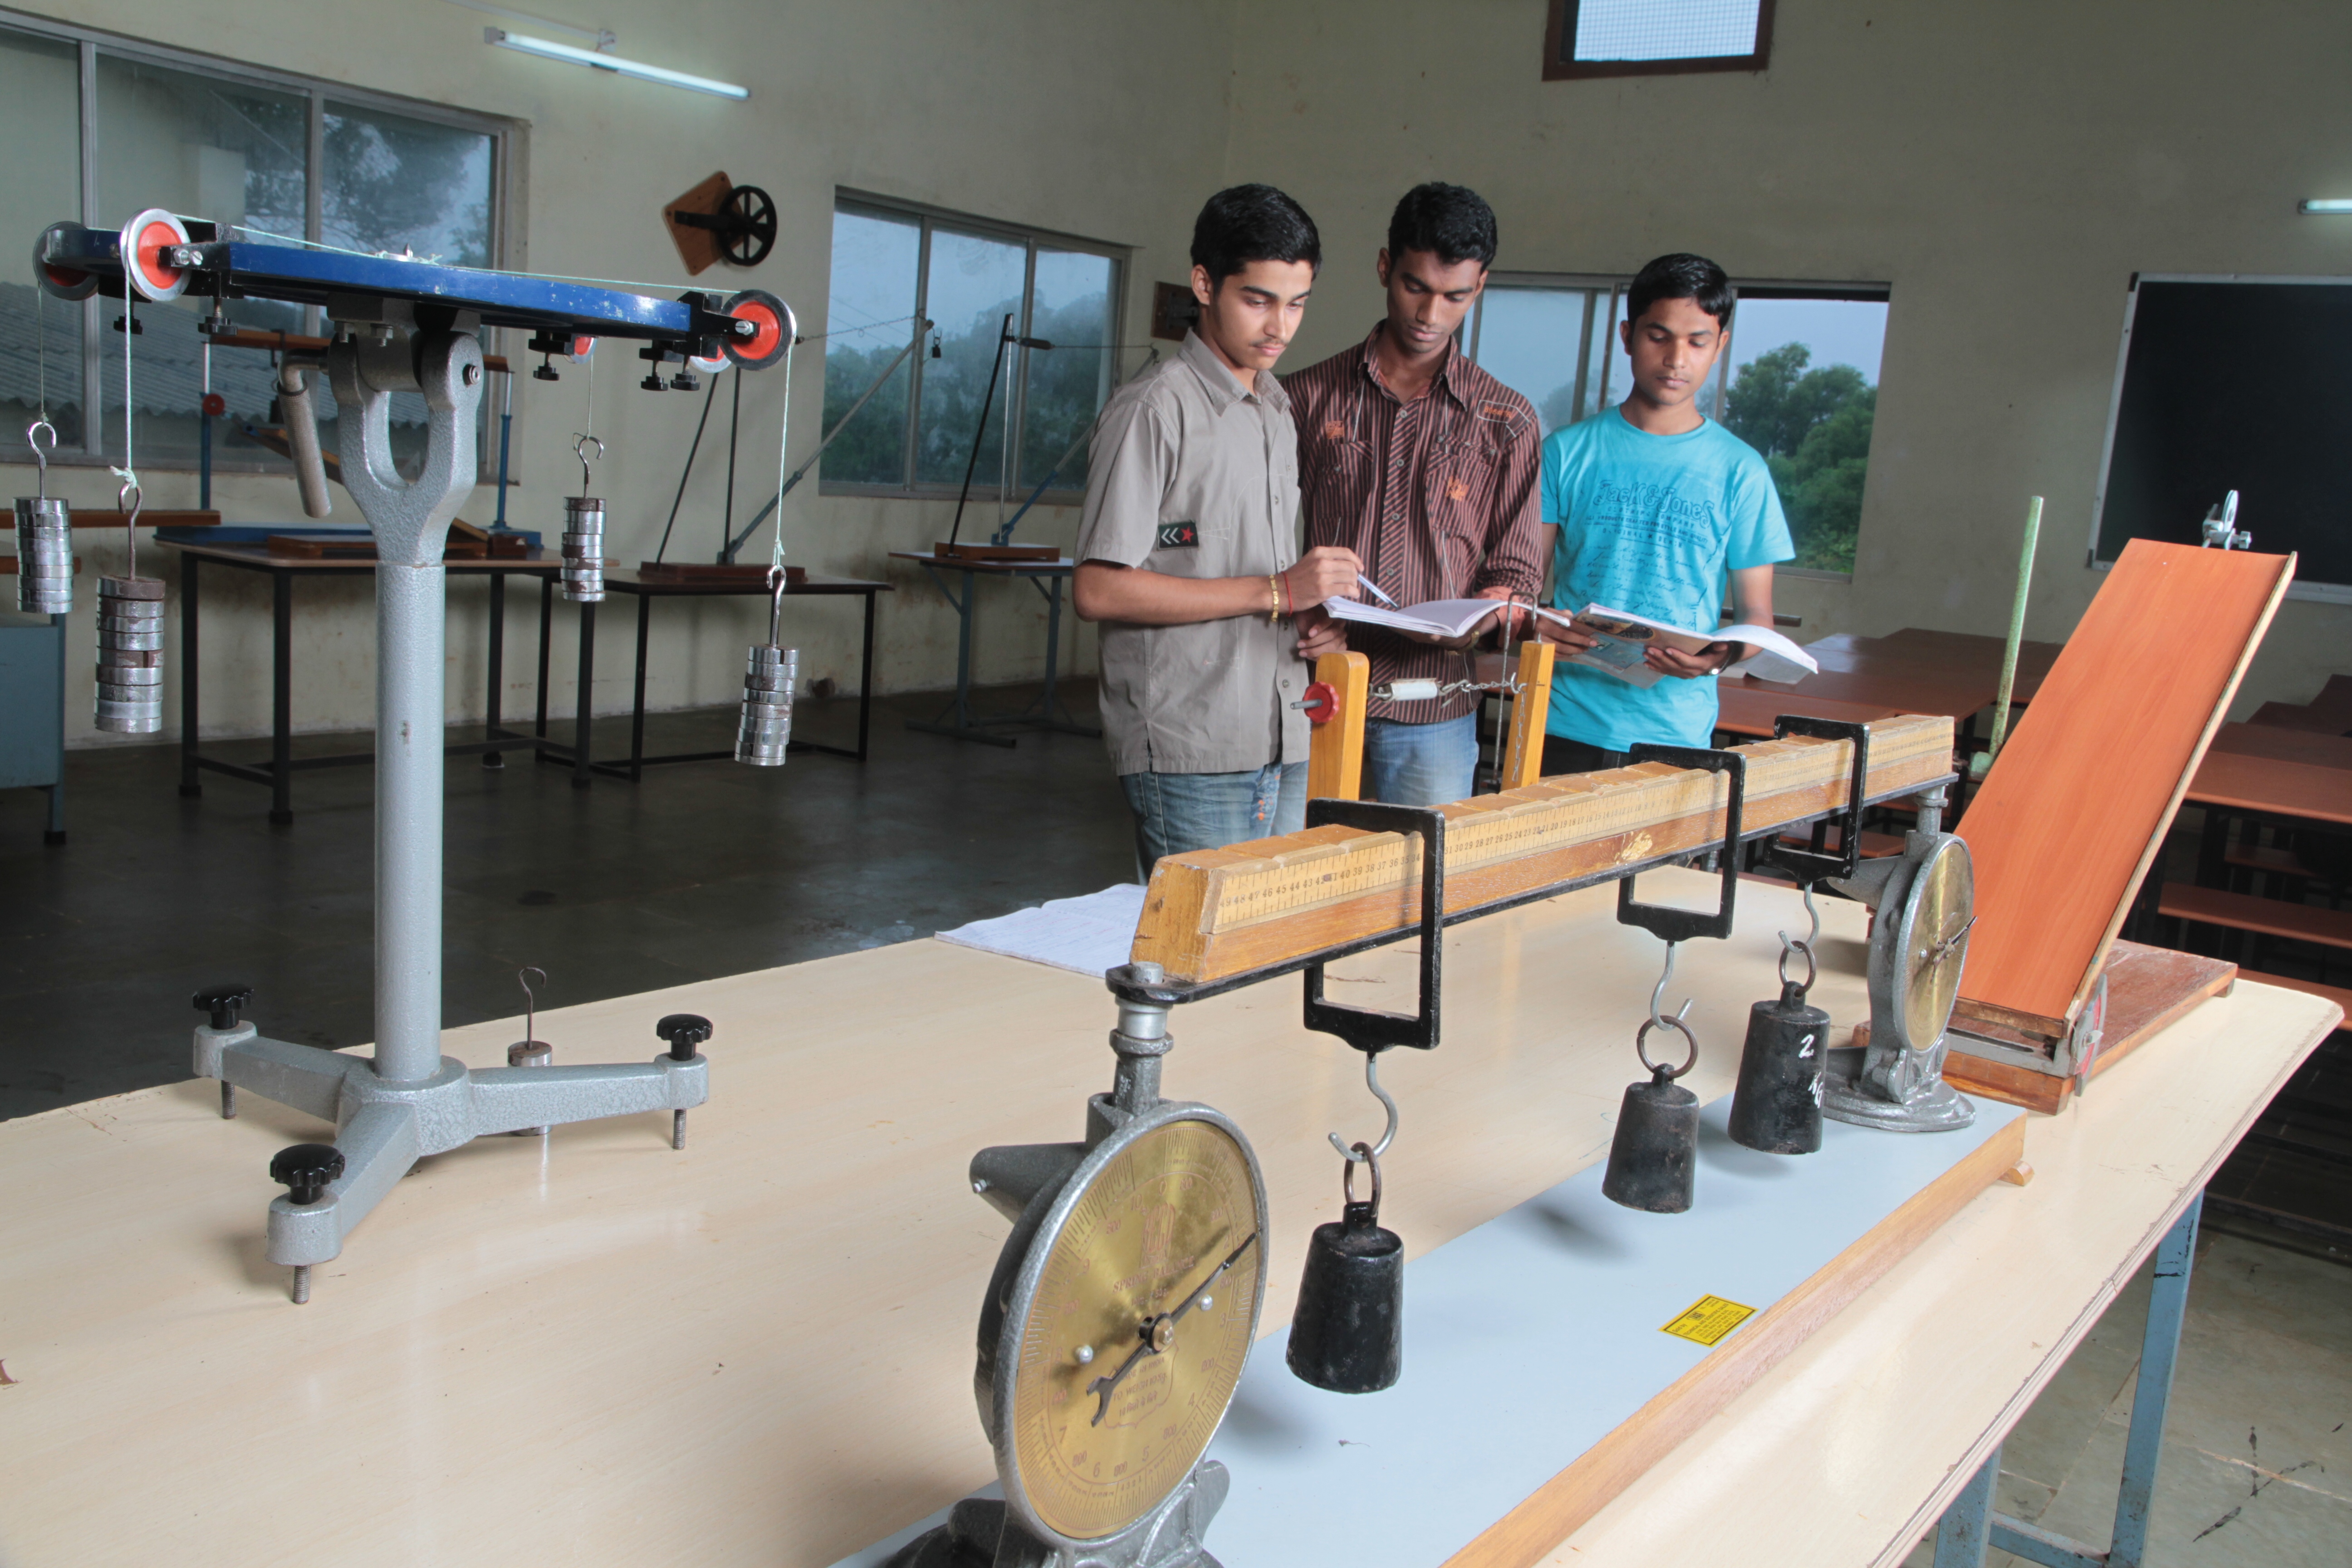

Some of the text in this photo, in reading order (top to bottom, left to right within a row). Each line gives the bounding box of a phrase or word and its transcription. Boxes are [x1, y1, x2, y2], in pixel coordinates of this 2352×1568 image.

[1643, 485, 1661, 507] &
[1656, 511, 1695, 529] COMPANY
[1455, 844, 1463, 853] 30
[1465, 841, 1473, 850] 29
[1475, 838, 1484, 848] 28
[1485, 837, 1493, 846] 27
[1495, 834, 1503, 843] 26
[1505, 832, 1513, 841] 25
[1514, 830, 1522, 839] 24
[1524, 828, 1531, 837] 23
[1551, 822, 1558, 830] 20
[1560, 820, 1567, 829] 19
[1569, 818, 1576, 827] 18
[1577, 816, 1585, 825] 17
[1586, 815, 1592, 823] 16
[1594, 812, 1602, 821] 15
[1603, 811, 1609, 819] 14
[1233, 894, 1245, 904] 48
[1249, 890, 1260, 901] 47
[1263, 888, 1273, 898] 46
[1276, 884, 1286, 895] 45
[1290, 882, 1300, 892] 44
[1303, 878, 1313, 888] 43
[1340, 870, 1350, 879] 40
[1353, 867, 1362, 876] 39
[1365, 863, 1375, 873] 38
[1377, 861, 1386, 871] 37
[1389, 858, 1398, 868] 36
[1401, 855, 1409, 865] 35
[1411, 853, 1420, 862] 34
[1798, 1034, 1814, 1058] 2
[1131, 1194, 1142, 1211] 10
[1223, 1234, 1230, 1250] 2
[1112, 1270, 1148, 1293] SPRING
[1220, 1313, 1226, 1328] 3
[1149, 1357, 1165, 1369] INDIA
[1113, 1390, 1123, 1402] TO
[1126, 1378, 1148, 1397] WEIGH
[1188, 1392, 1195, 1406] 4
[1059, 1425, 1068, 1444] 7
[1142, 1446, 1149, 1462] 5
[1093, 1462, 1101, 1478] 6
